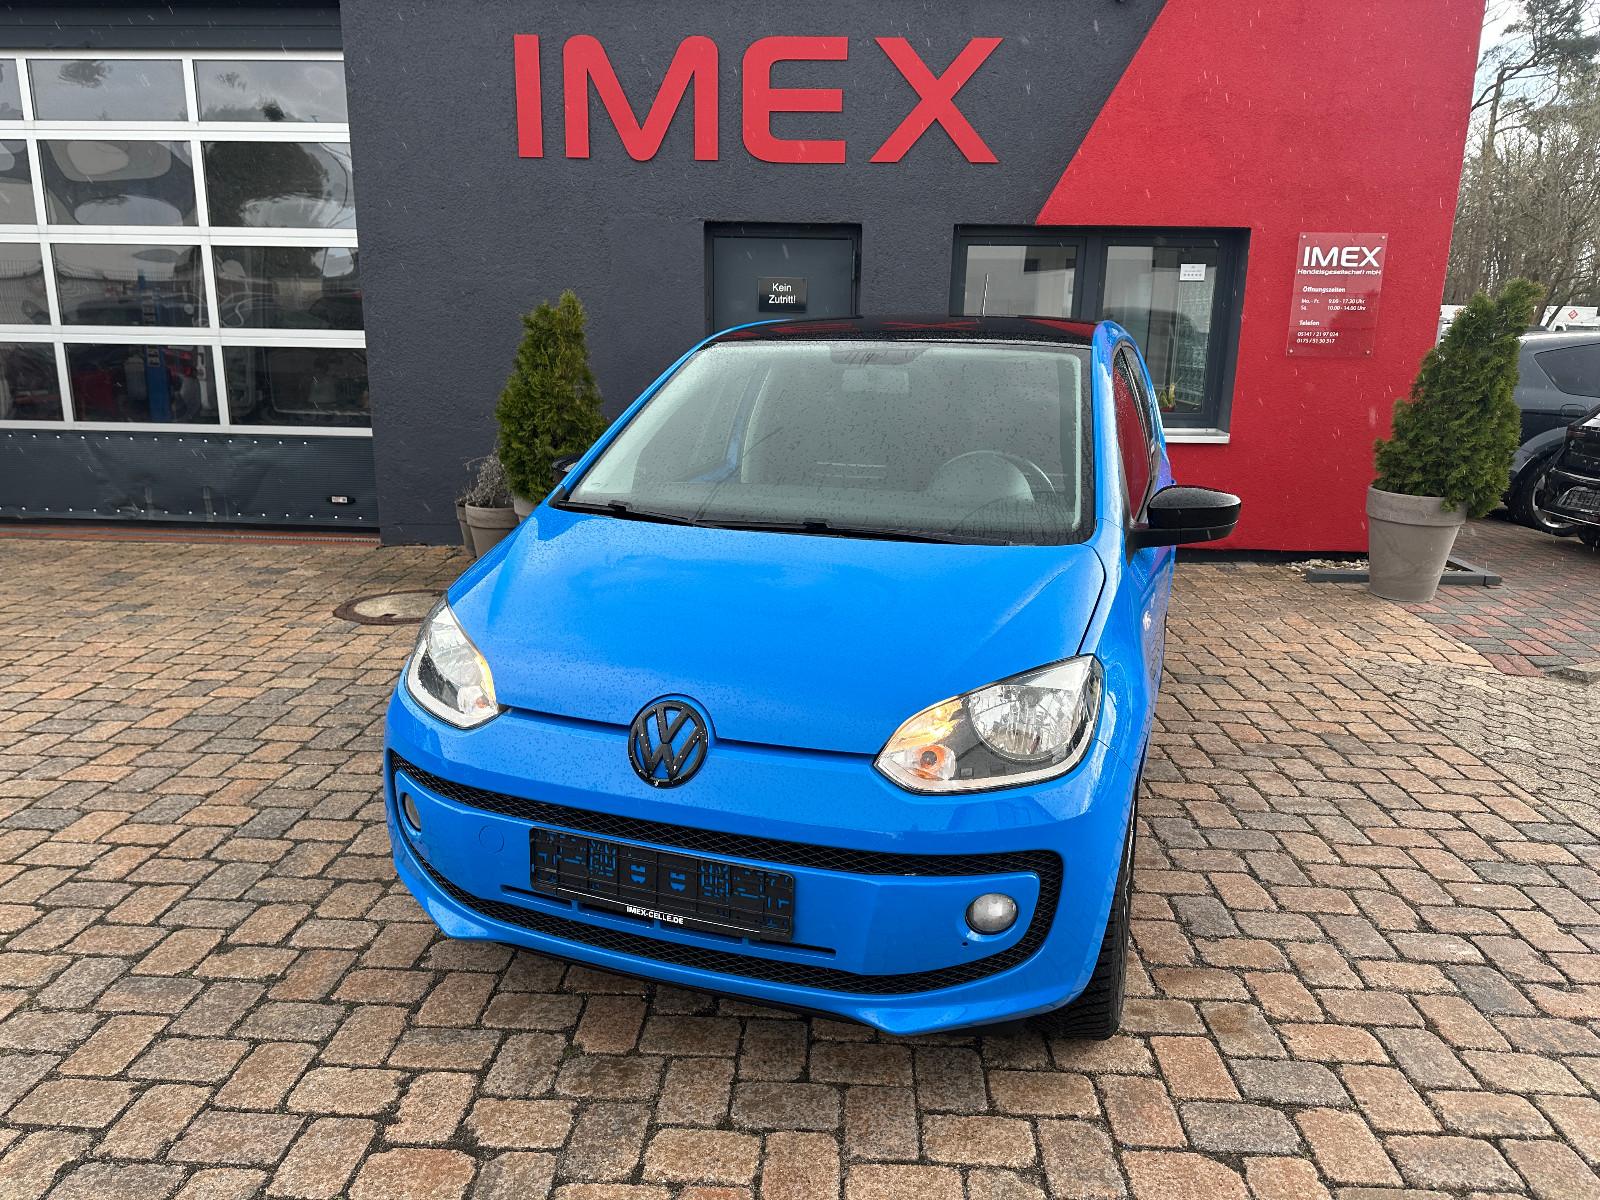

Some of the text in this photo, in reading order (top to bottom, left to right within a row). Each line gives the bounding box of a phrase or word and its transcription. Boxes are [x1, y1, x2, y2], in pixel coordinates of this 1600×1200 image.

[513, 33, 1004, 164] IMEX
[1302, 246, 1382, 267] IMEX
[772, 282, 792, 292] Kein
[1302, 285, 1346, 293] Öffnungszeiten
[768, 294, 796, 304] Zutritt!
[626, 905, 684, 925] IMEX-CELLE.DE
